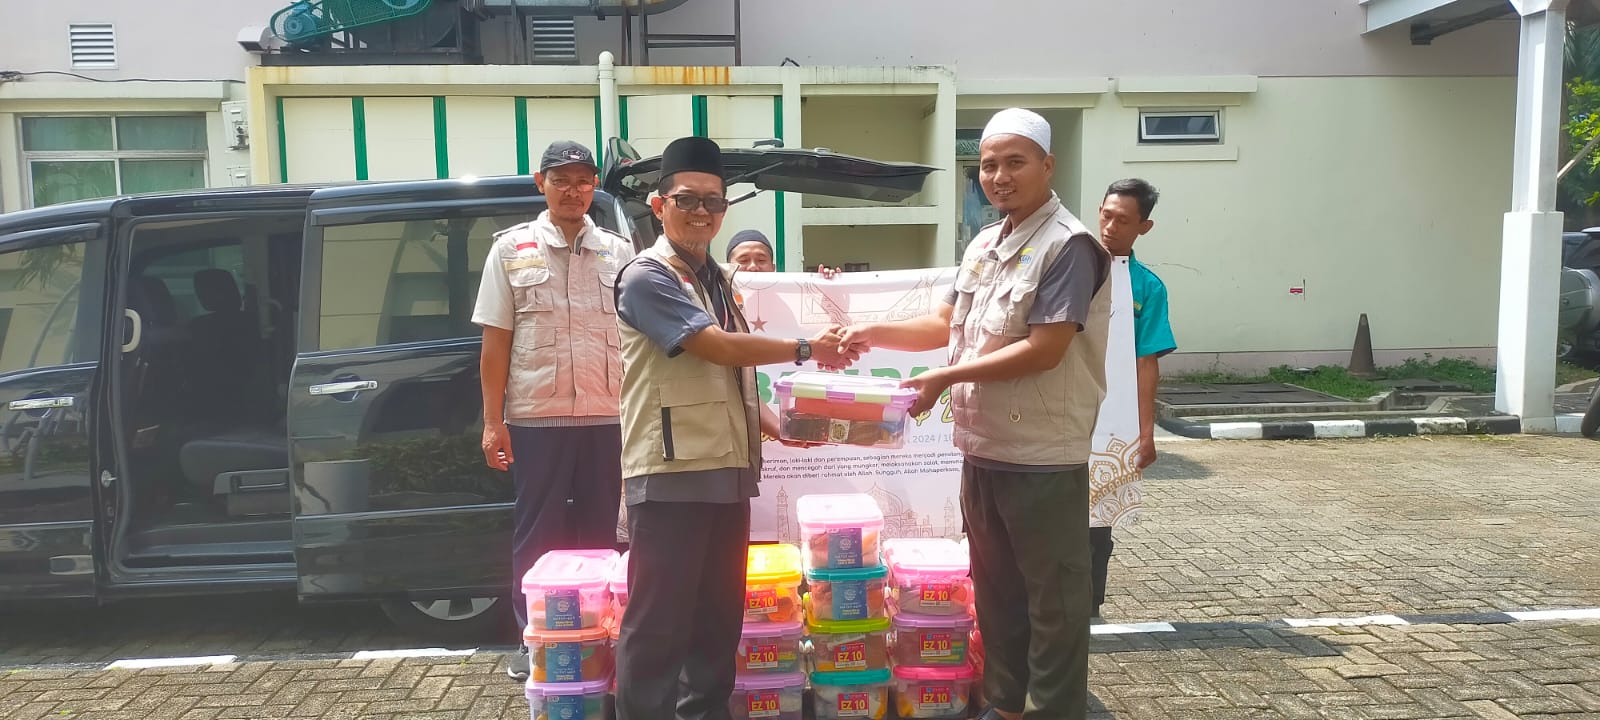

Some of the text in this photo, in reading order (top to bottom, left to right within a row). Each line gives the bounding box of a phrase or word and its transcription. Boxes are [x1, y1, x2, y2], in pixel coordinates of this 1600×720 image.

[912, 434, 935, 443] 2024
[924, 591, 948, 600] EZ 10
[750, 597, 774, 608] EZ 10
[924, 639, 947, 650] EZ 10
[750, 651, 774, 662] EZ 10
[838, 651, 862, 661] EZ 10
[923, 693, 947, 703] EZ 10
[752, 700, 776, 711] EZ 10
[841, 700, 865, 710] EZ 10
